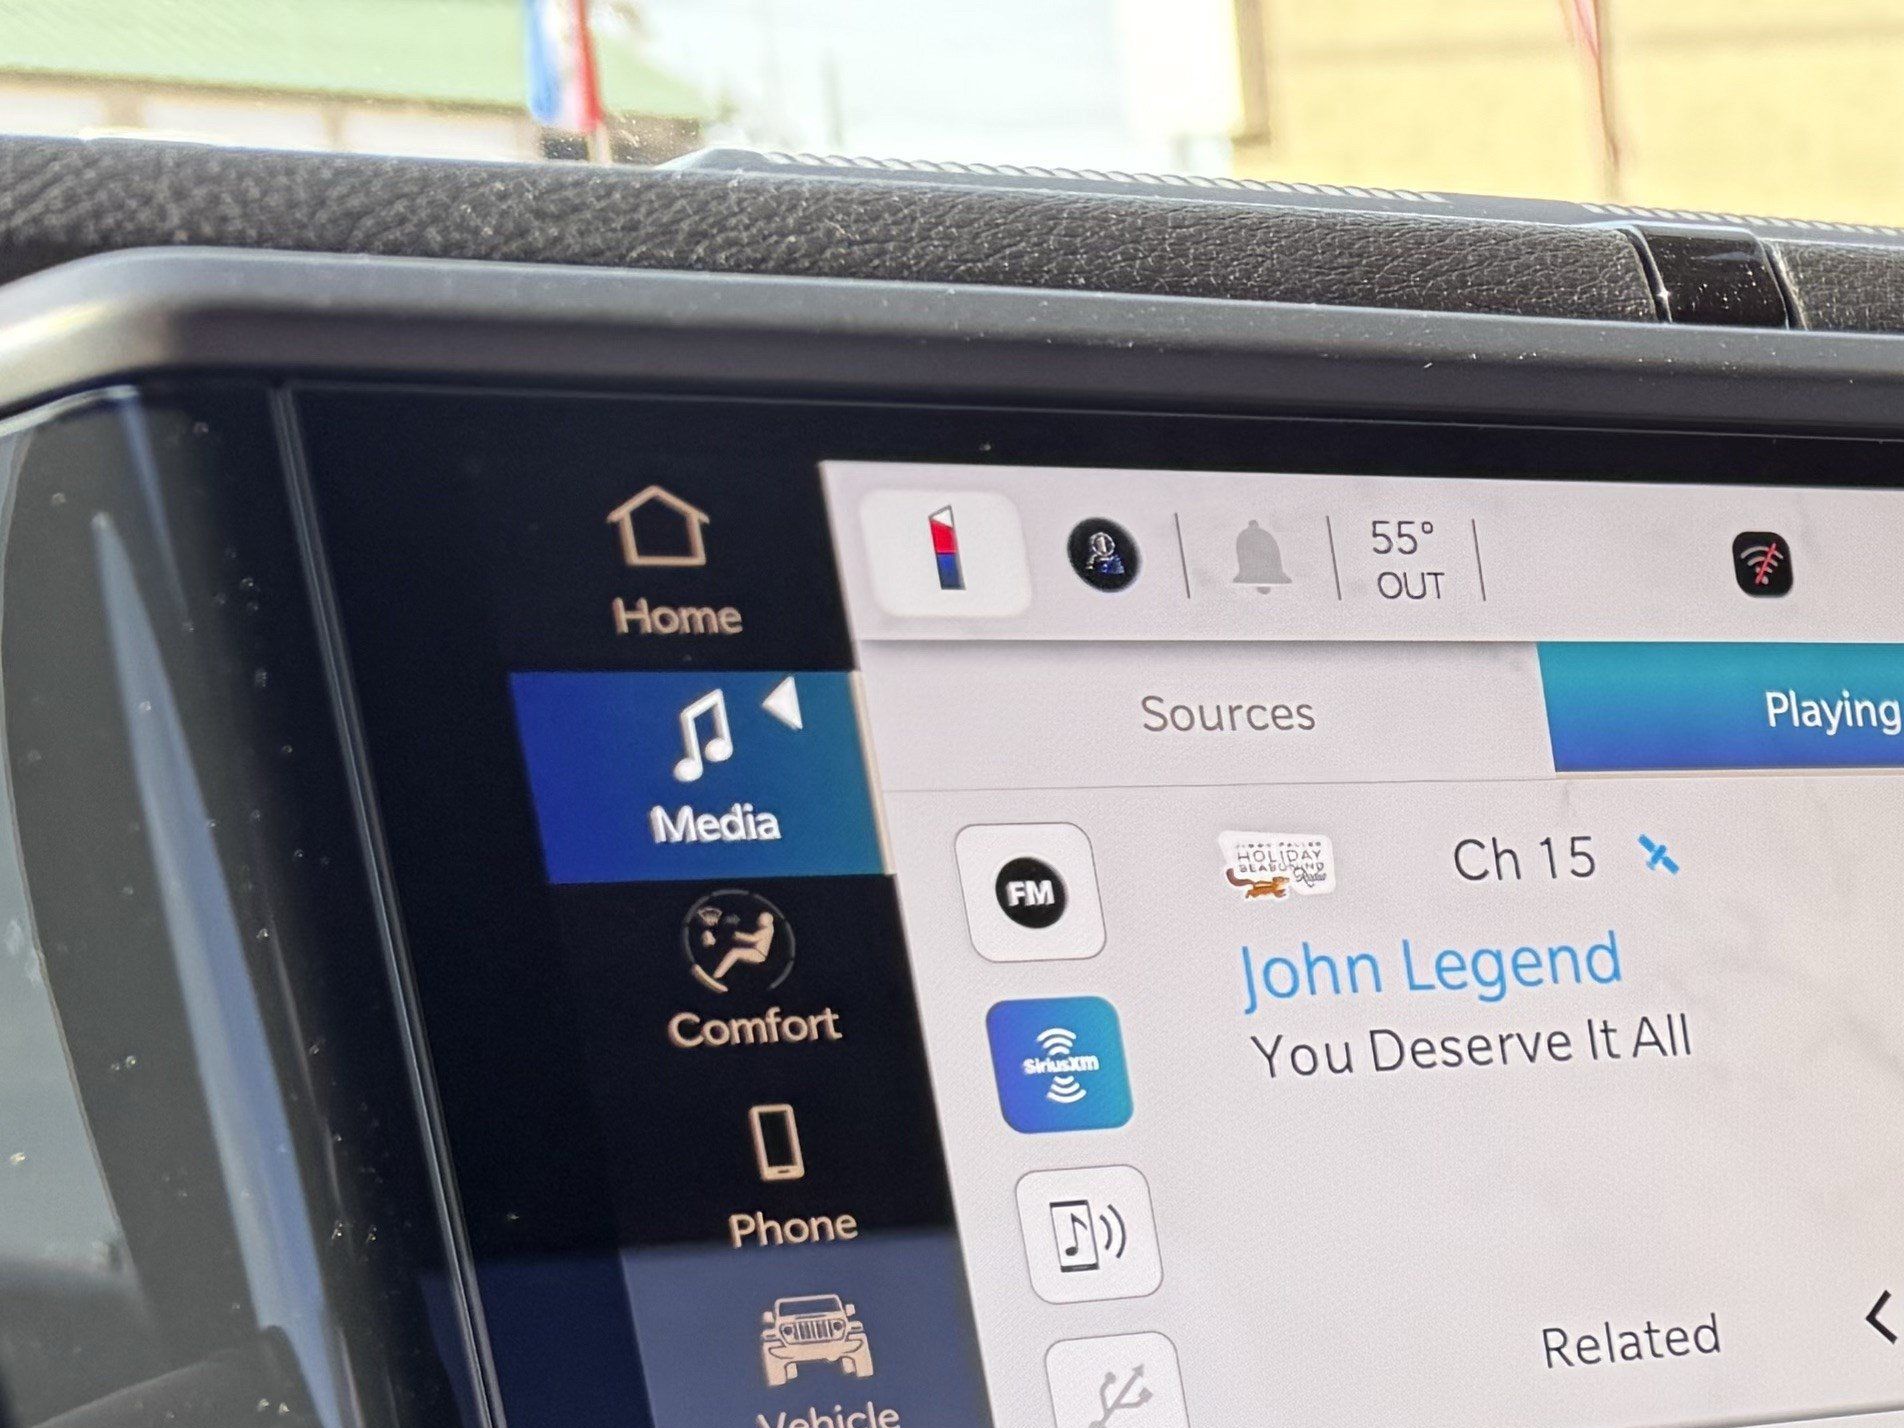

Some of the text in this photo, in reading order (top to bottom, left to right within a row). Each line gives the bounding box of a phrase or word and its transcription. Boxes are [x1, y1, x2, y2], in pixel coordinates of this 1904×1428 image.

[1377, 571, 1445, 600] OUT
[612, 597, 743, 635] Home
[1141, 694, 1317, 733] Sources
[1765, 690, 1903, 735] Playing
[650, 805, 781, 844] Media
[1237, 849, 1321, 863] HOLIDAY
[1454, 835, 1597, 883] Ch 15
[1005, 880, 1054, 907] FM
[1241, 930, 1622, 1015] John Legend
[668, 1007, 842, 1048] Comfort
[1252, 1012, 1692, 1080] You Deserve It All
[728, 1212, 858, 1249] Phone
[1541, 1311, 1722, 1369] Related
